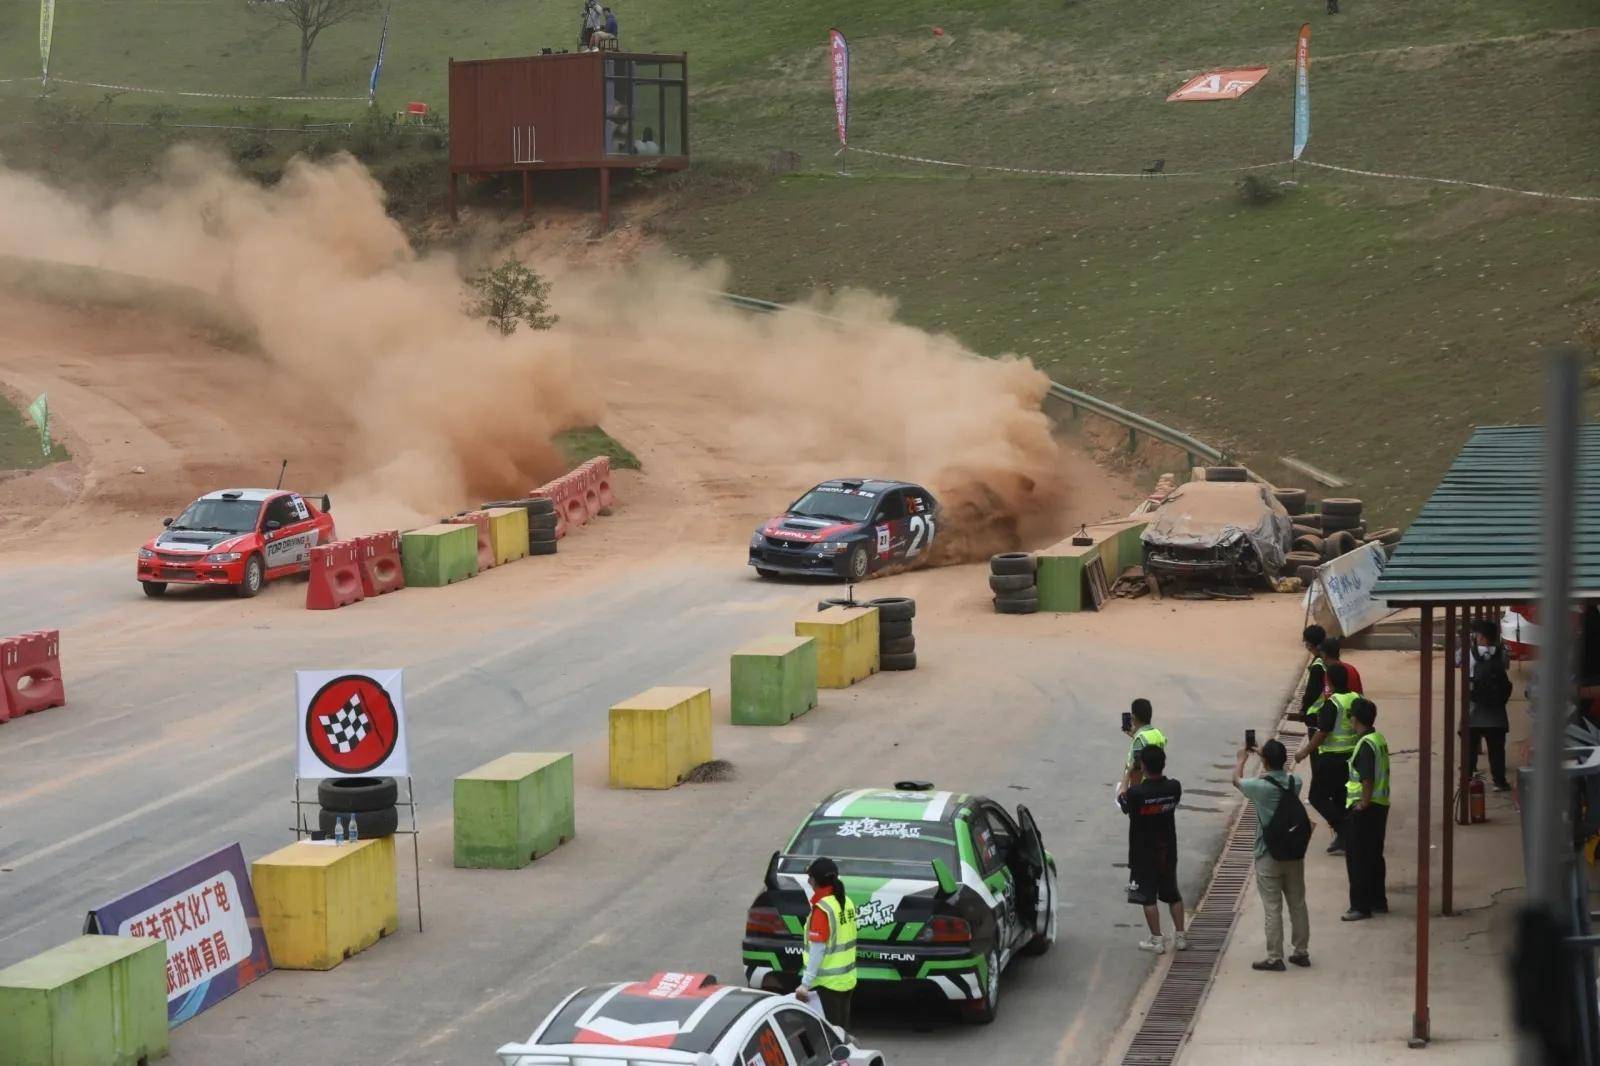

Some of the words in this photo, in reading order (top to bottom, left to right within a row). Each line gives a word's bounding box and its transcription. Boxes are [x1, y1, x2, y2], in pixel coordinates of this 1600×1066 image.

[267, 541, 282, 557] TOP
[856, 900, 881, 918] UST
[857, 913, 881, 930] RIVE
[857, 951, 915, 961] RIVEIT.FUN
